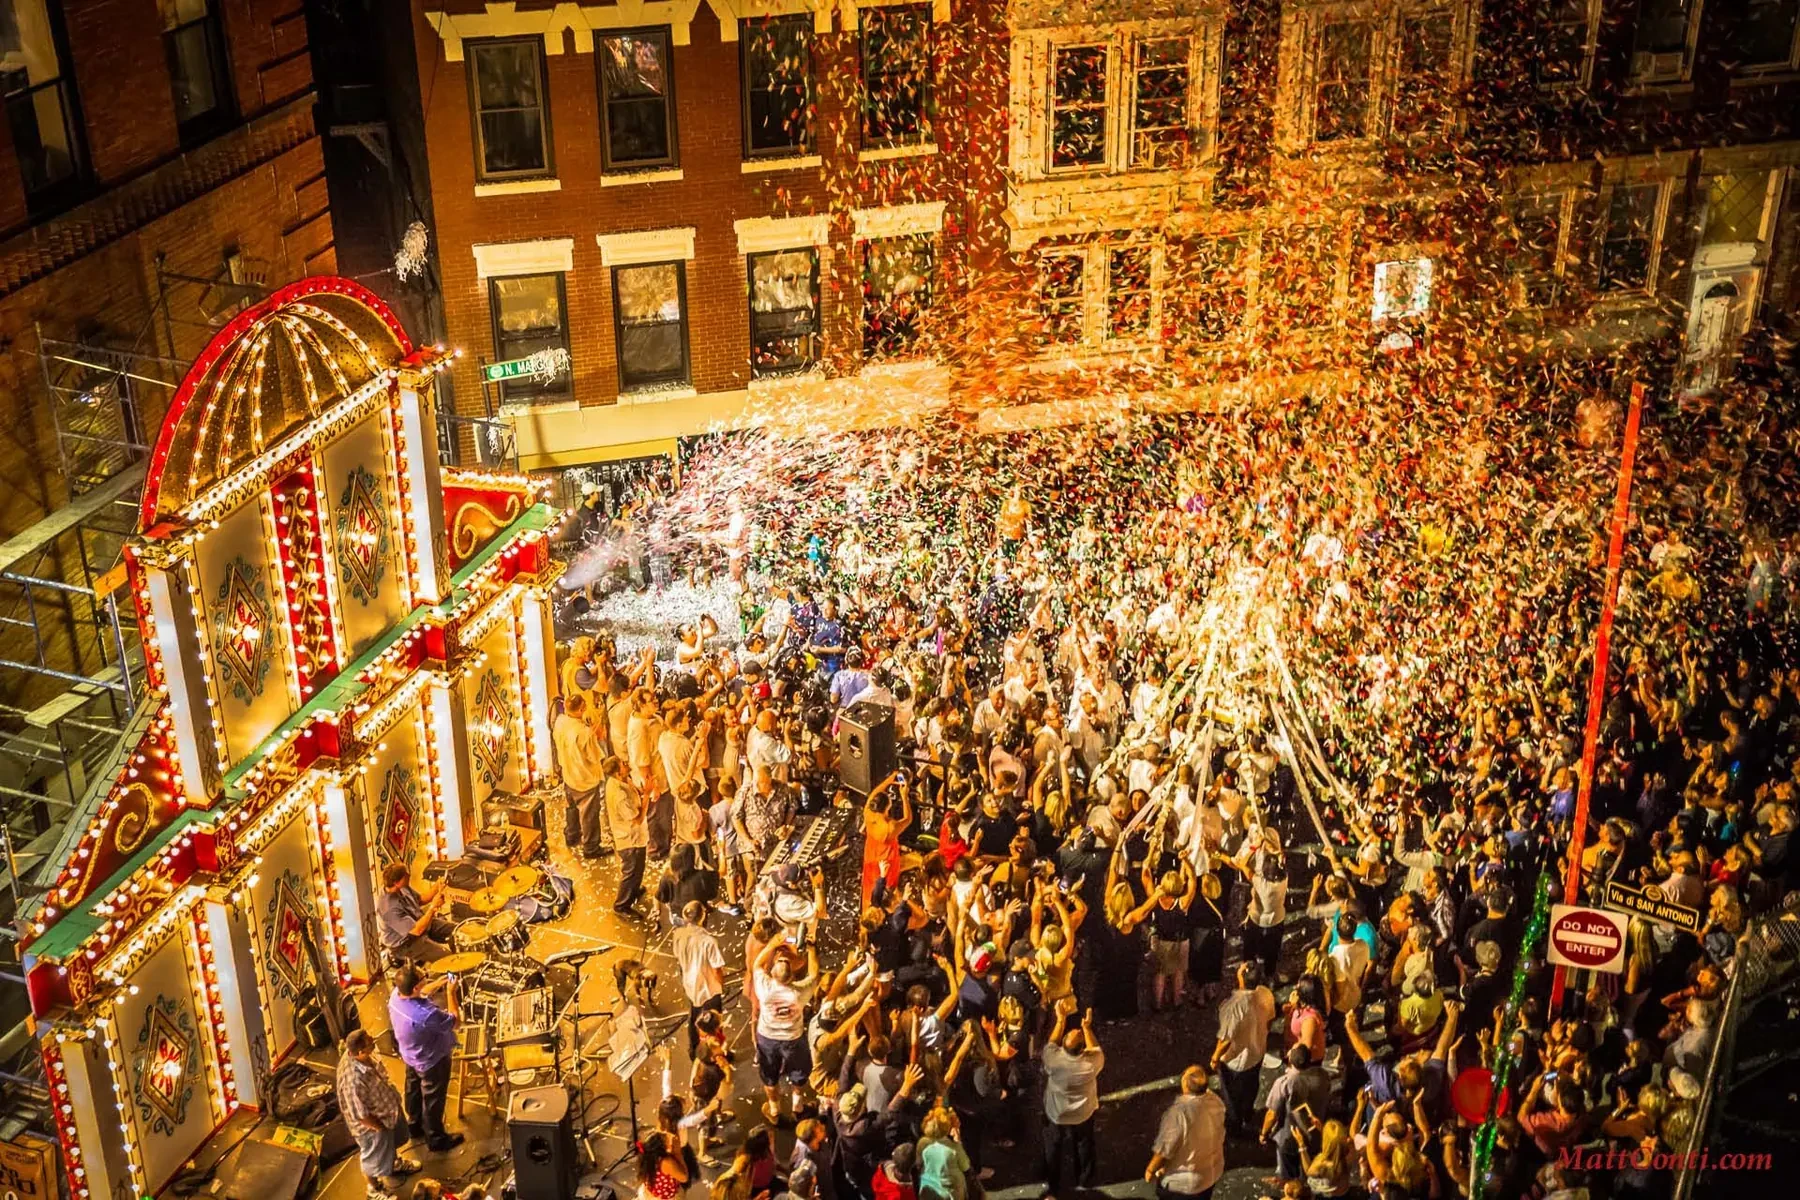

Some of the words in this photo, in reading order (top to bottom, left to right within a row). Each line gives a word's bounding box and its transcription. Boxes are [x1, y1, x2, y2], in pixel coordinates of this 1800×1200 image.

[504, 363, 515, 376] N.
[1611, 889, 1624, 903] Via
[1626, 896, 1635, 906] di
[1636, 900, 1654, 913] SAN
[1656, 905, 1694, 925] ANTONIO
[1562, 920, 1581, 931] DO
[1587, 923, 1613, 936] NOT
[1565, 942, 1606, 957] ENTER
